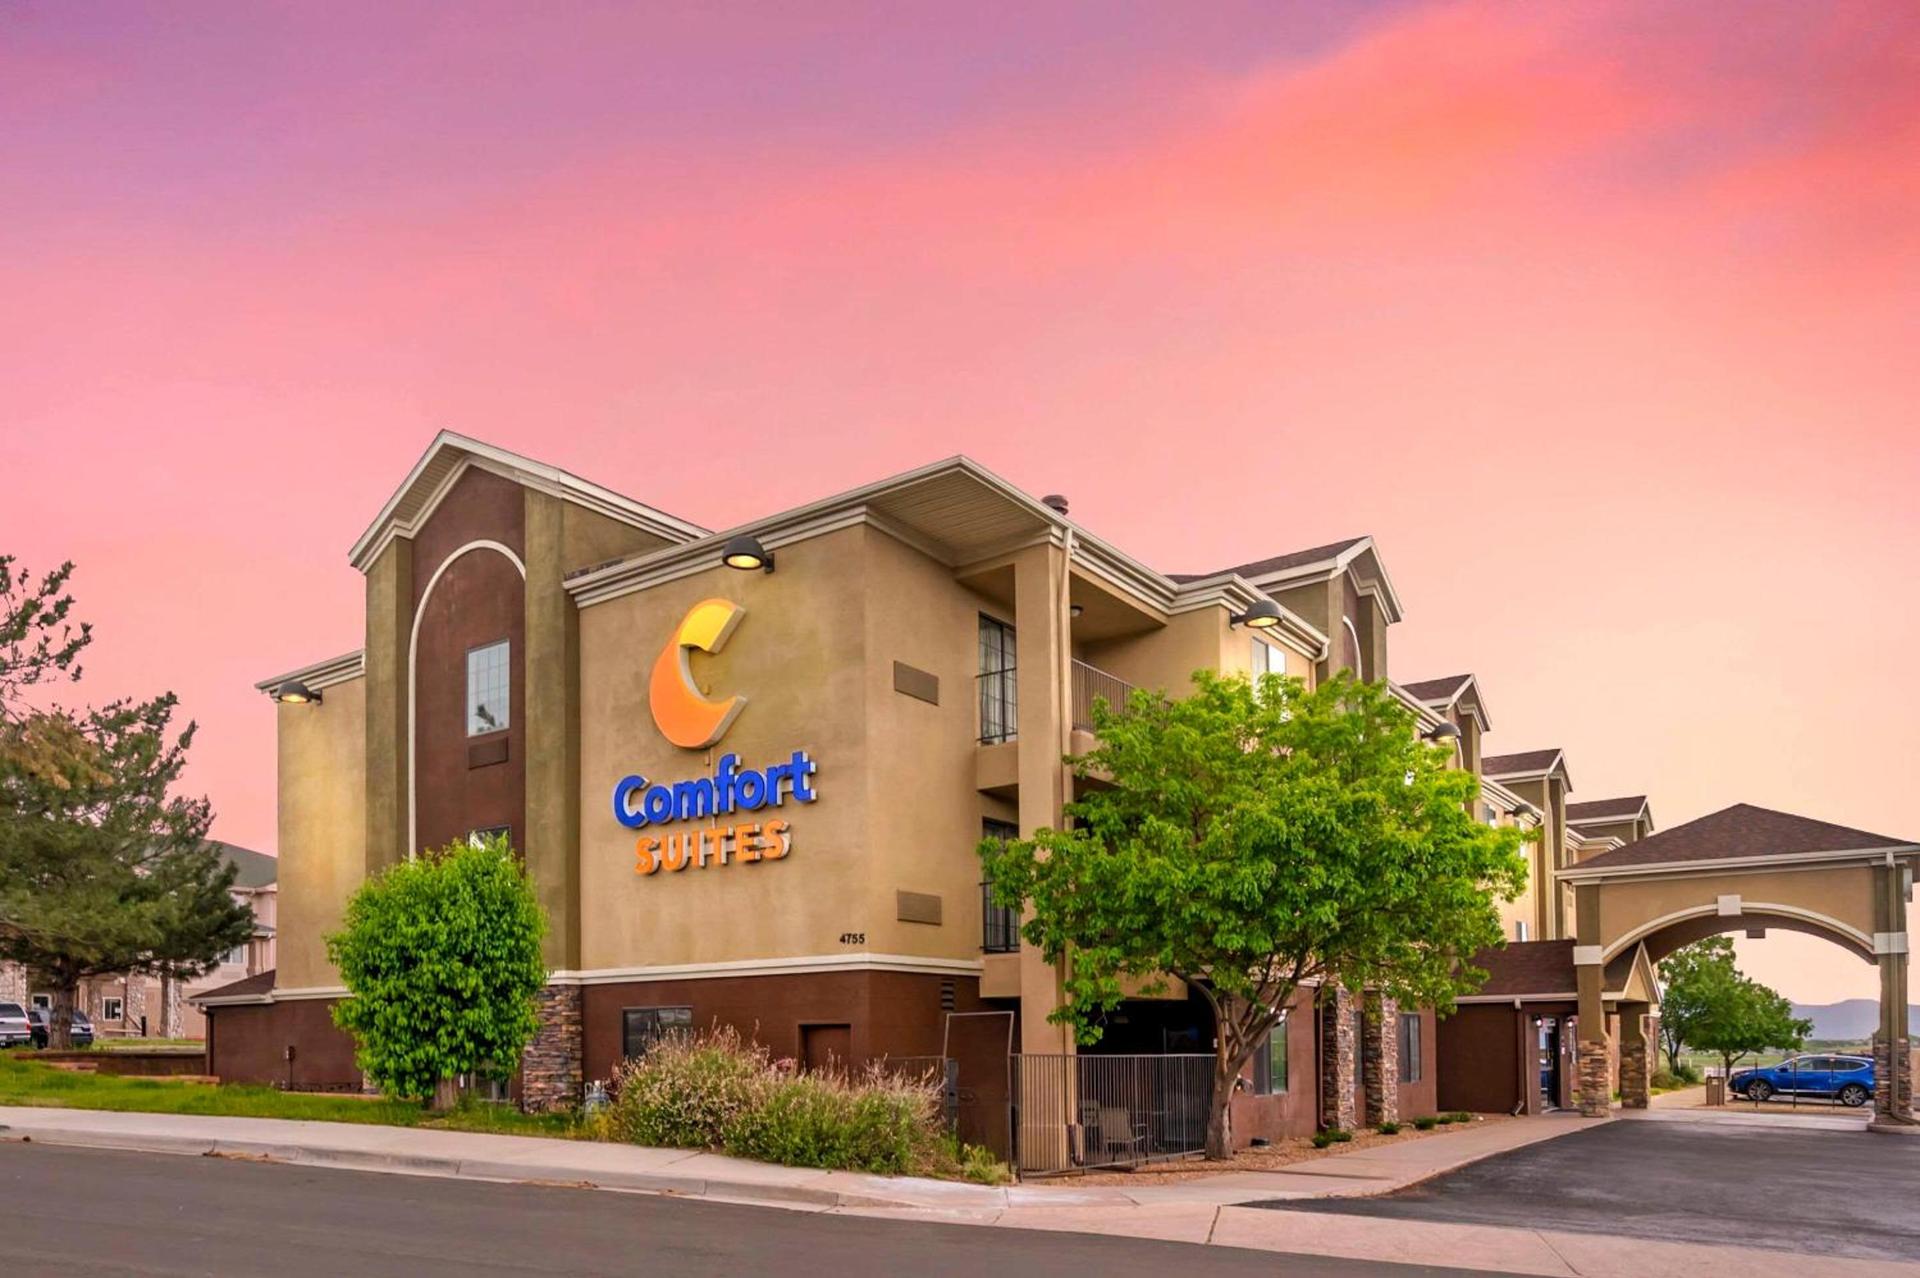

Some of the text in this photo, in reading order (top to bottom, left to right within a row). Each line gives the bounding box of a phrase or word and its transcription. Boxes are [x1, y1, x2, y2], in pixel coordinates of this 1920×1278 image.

[613, 750, 815, 829] Comfort
[635, 819, 791, 875] SUITES
[839, 933, 865, 945] 4755
